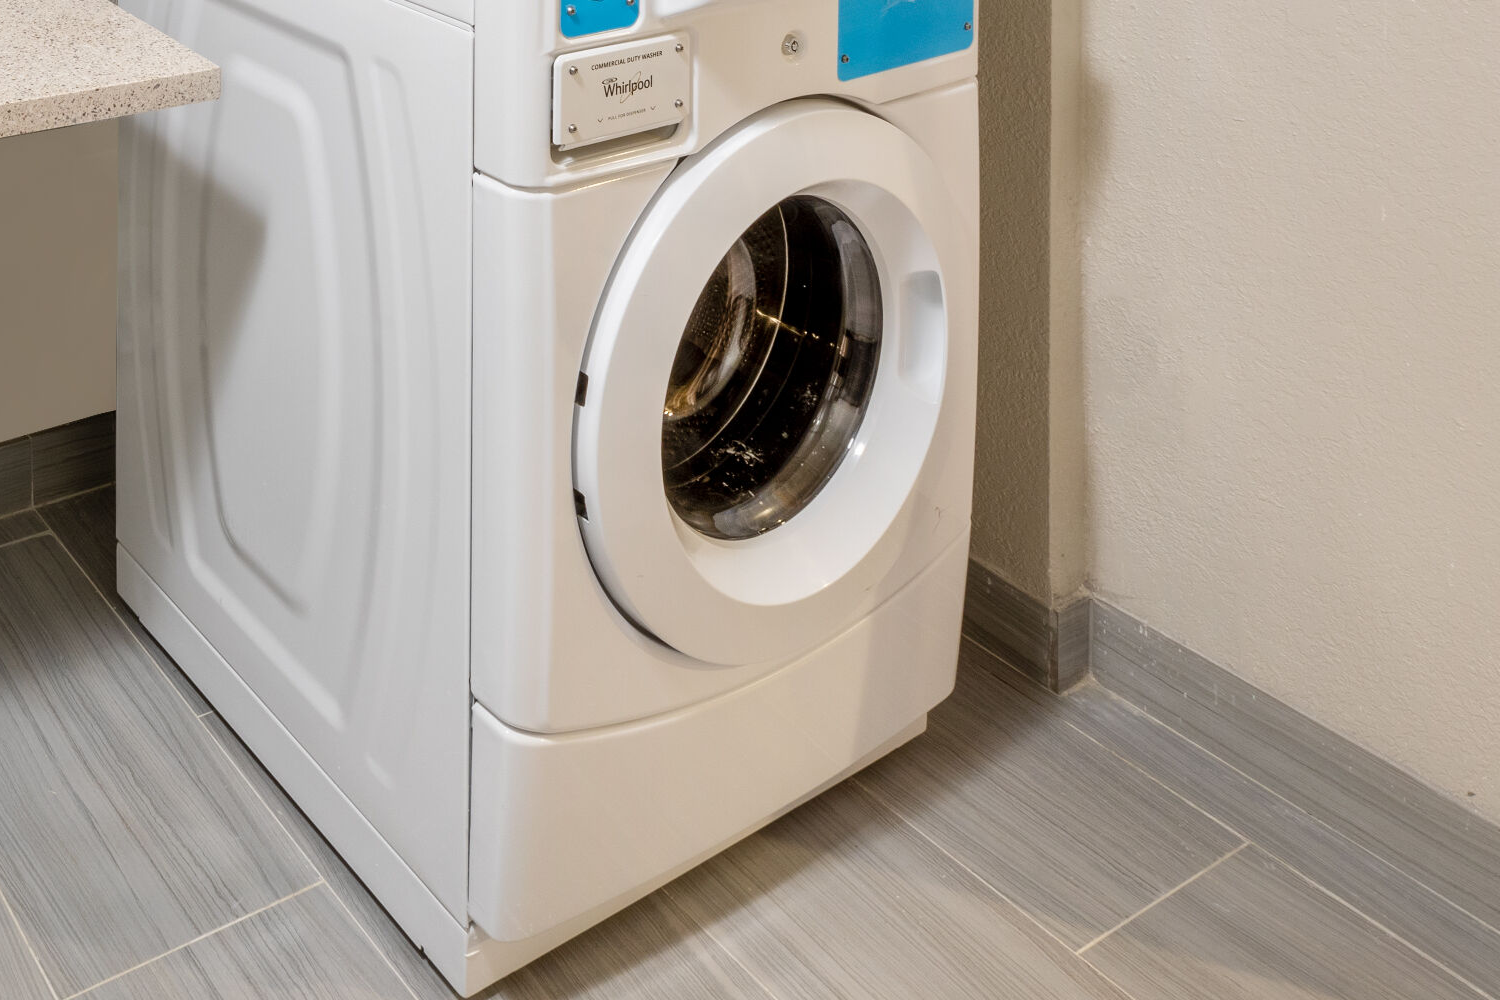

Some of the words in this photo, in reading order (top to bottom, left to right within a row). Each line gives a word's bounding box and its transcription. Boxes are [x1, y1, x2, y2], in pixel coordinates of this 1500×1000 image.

[591, 59, 626, 71] COMMERCIAL
[627, 55, 640, 63] DUTY
[641, 50, 663, 60] WASHER
[603, 75, 653, 98] Whirlpool
